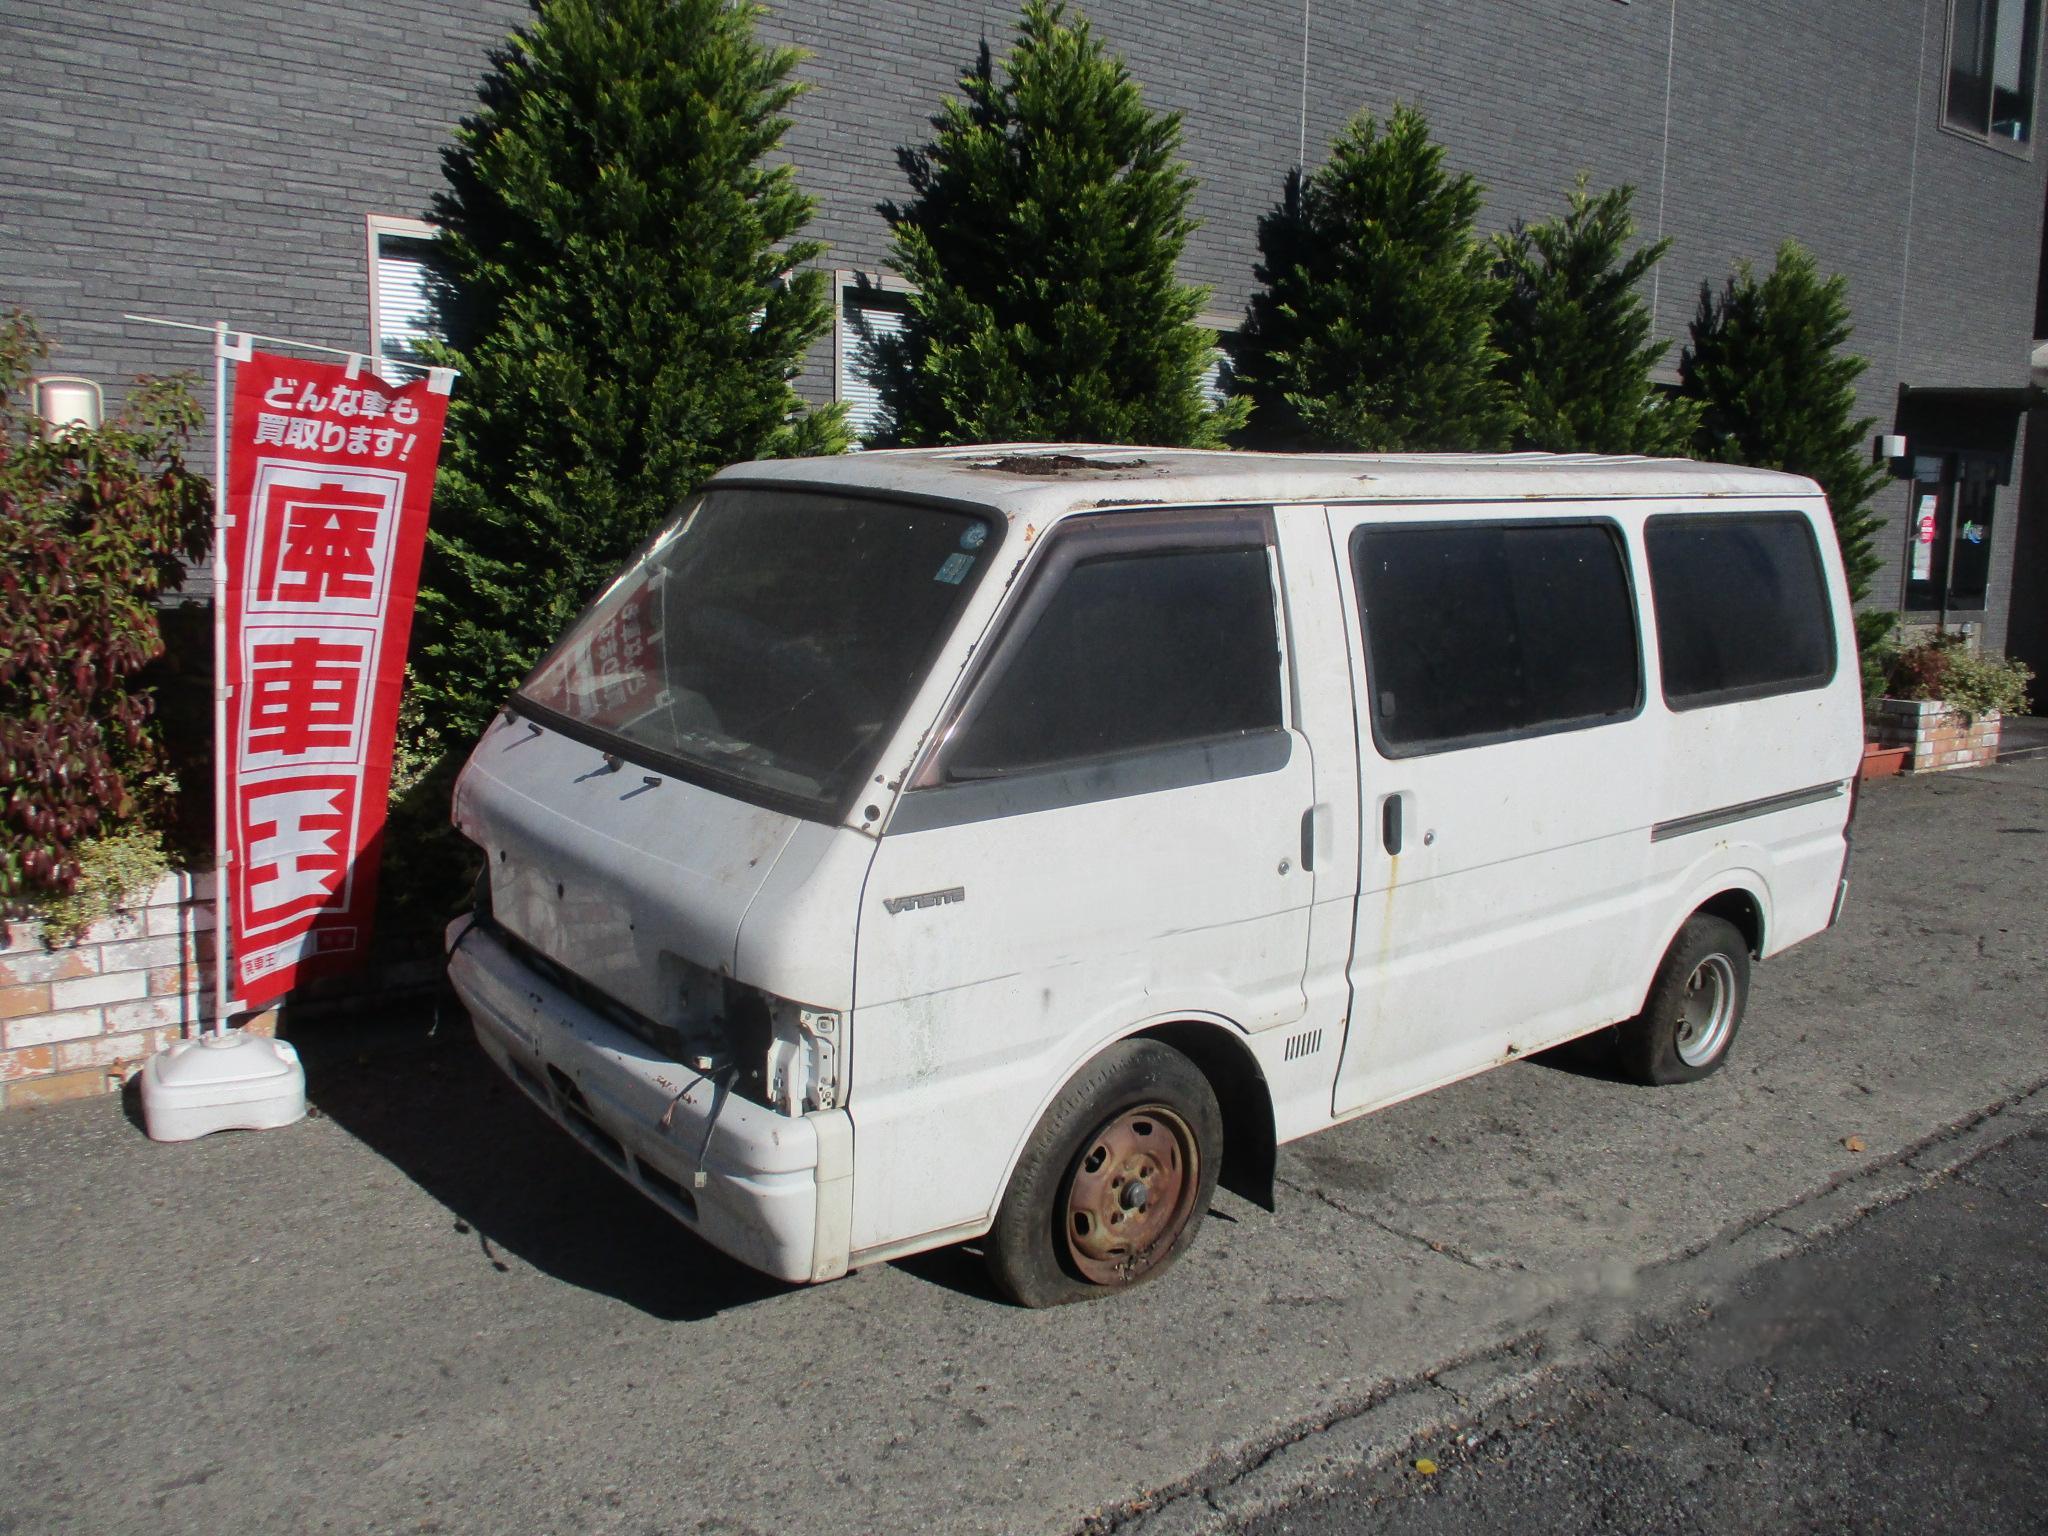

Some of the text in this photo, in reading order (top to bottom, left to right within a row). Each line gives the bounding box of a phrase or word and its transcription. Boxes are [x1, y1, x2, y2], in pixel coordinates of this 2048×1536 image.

[264, 377, 419, 424] どんな車も
[253, 412, 417, 461] 買取ります!
